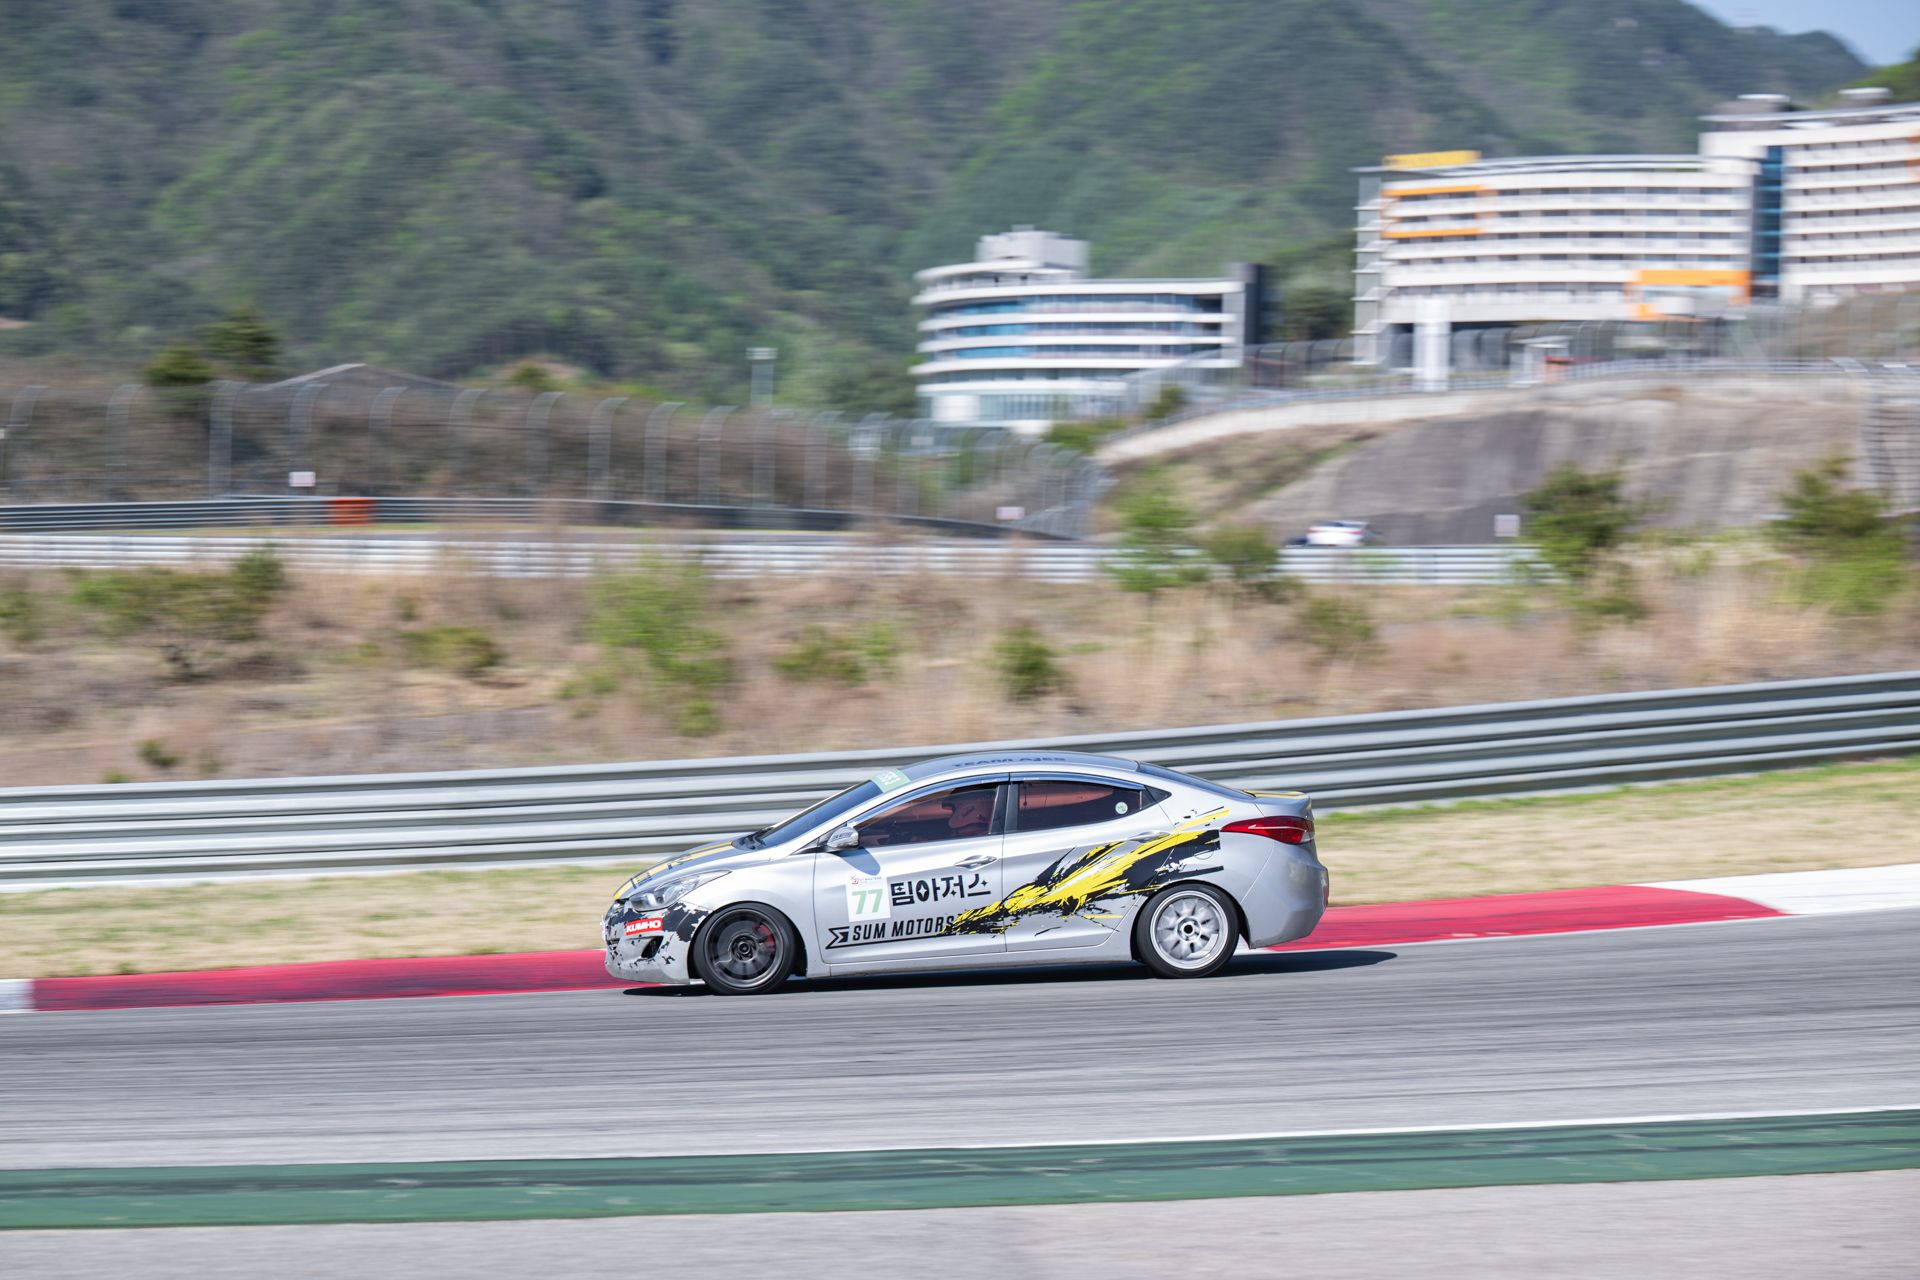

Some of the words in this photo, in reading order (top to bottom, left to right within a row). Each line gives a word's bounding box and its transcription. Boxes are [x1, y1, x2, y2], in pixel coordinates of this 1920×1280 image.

[890, 873, 991, 906] 팀아저스
[852, 889, 883, 915] 77
[626, 919, 661, 933] KUMHO
[852, 922, 886, 941] SUM
